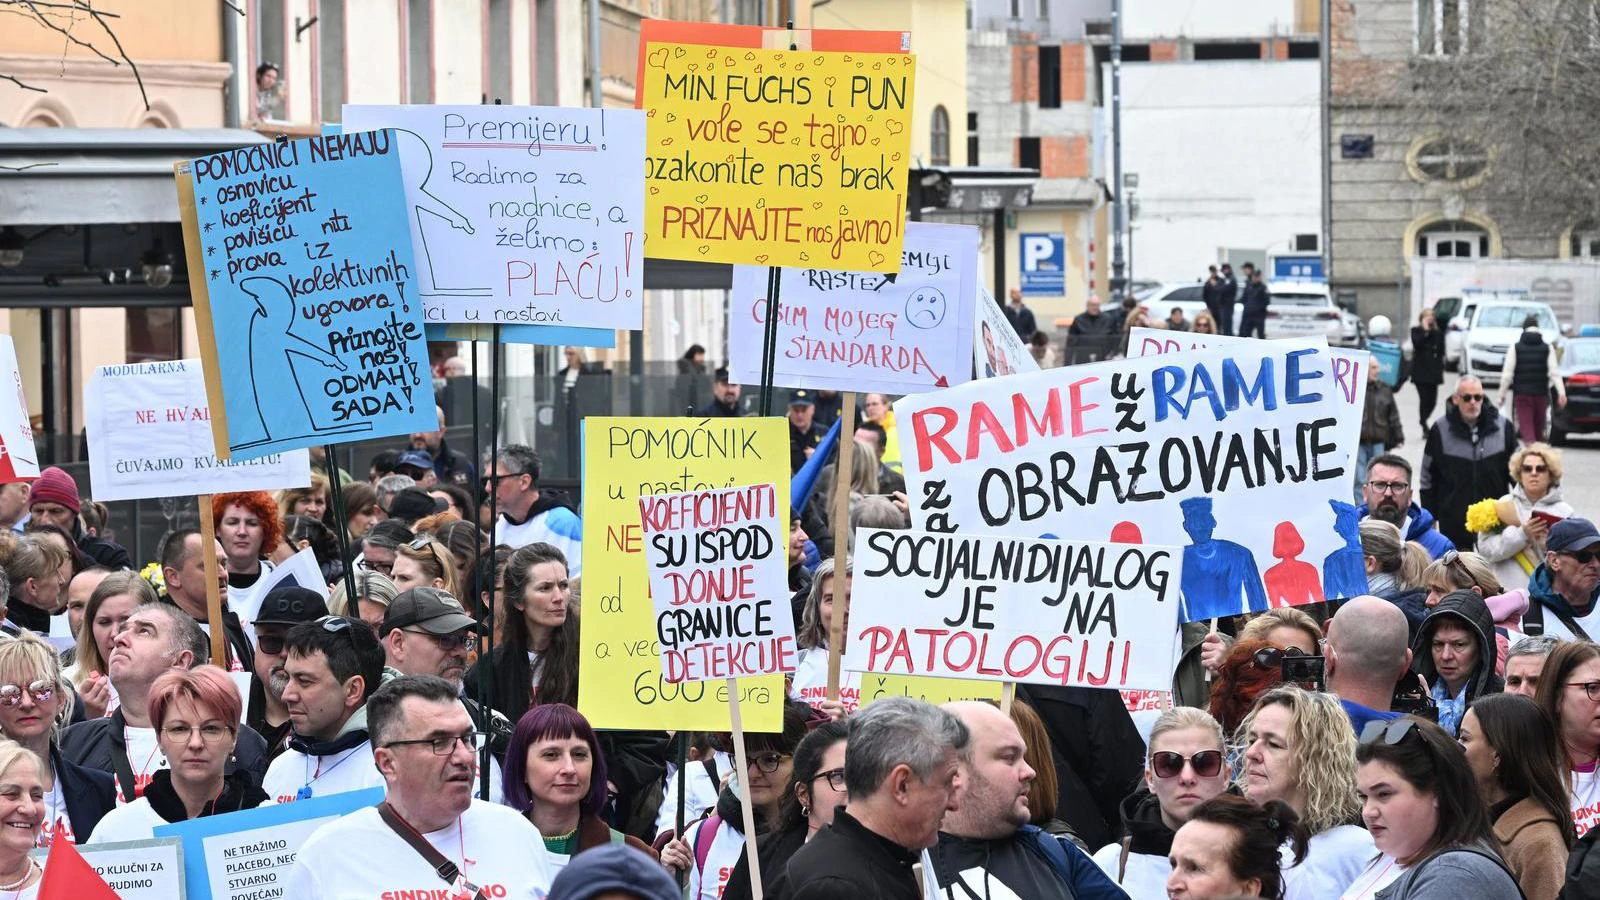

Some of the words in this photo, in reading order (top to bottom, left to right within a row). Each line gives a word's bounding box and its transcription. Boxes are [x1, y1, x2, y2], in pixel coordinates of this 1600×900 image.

[664, 73, 718, 101] MIN.
[726, 75, 812, 106] FUCHS
[851, 75, 906, 110] PUN
[309, 128, 390, 163] NEMAJU
[444, 109, 607, 157] Premijeru!
[687, 102, 742, 143] vole
[757, 120, 788, 145] se
[803, 113, 866, 161] tajno
[217, 173, 298, 205] osnovicu
[451, 160, 537, 185] Radimo
[556, 172, 586, 186] za
[778, 153, 823, 188] naš
[841, 154, 895, 191] brak
[220, 186, 317, 230] koeficijent
[489, 186, 599, 227] nadnice,
[608, 205, 629, 224] a
[662, 205, 803, 244] PRIZNAJTE
[806, 224, 833, 244] nas
[223, 223, 299, 259] povišicu
[321, 208, 352, 236] niti
[495, 217, 598, 253] želimo:
[227, 250, 287, 285] prava
[303, 242, 334, 261] iz
[288, 249, 411, 298] kolektivnih
[507, 232, 634, 303] PLAĆU!
[465, 308, 480, 320] u
[494, 301, 563, 323] nastavi
[824, 306, 898, 341] MOJEG
[327, 311, 423, 355] Priznajte
[102, 361, 187, 377] MODULARNA
[359, 341, 410, 370] nas!
[785, 334, 932, 375] STANDARDA
[323, 362, 421, 398] ODMAH!
[136, 410, 157, 424] NE
[331, 386, 415, 422] SADA!
[911, 376, 1109, 472] RAME
[1151, 347, 1324, 422] RAME
[609, 418, 762, 460] POMOĆNIK
[116, 455, 184, 474] ČUVAJMO
[978, 417, 1345, 528] OBRAZOVANJE
[608, 484, 625, 500] u
[639, 483, 776, 533] KOEFICIJENTI
[652, 533, 687, 569] SU
[695, 524, 774, 564] ISPOD
[663, 564, 756, 606] DONJE
[864, 530, 1023, 599] SOCIJALNI
[1024, 543, 1172, 607] DIJALOG
[600, 575, 624, 614] od
[944, 585, 998, 630] JE
[1063, 590, 1118, 638] NA
[656, 599, 774, 650] GRANICE
[595, 642, 612, 659] a
[663, 635, 798, 684] DETEKCIJE
[859, 626, 1131, 687] PATOLOGIJI
[224, 847, 238, 858] NE
[240, 839, 287, 855] TRAŽIMO
[226, 858, 275, 873] PLACEBO,
[107, 862, 148, 876] KLJUČNI
[150, 862, 164, 872] ZA
[109, 878, 153, 891] BUDIMO
[228, 872, 278, 889] STVARNO
